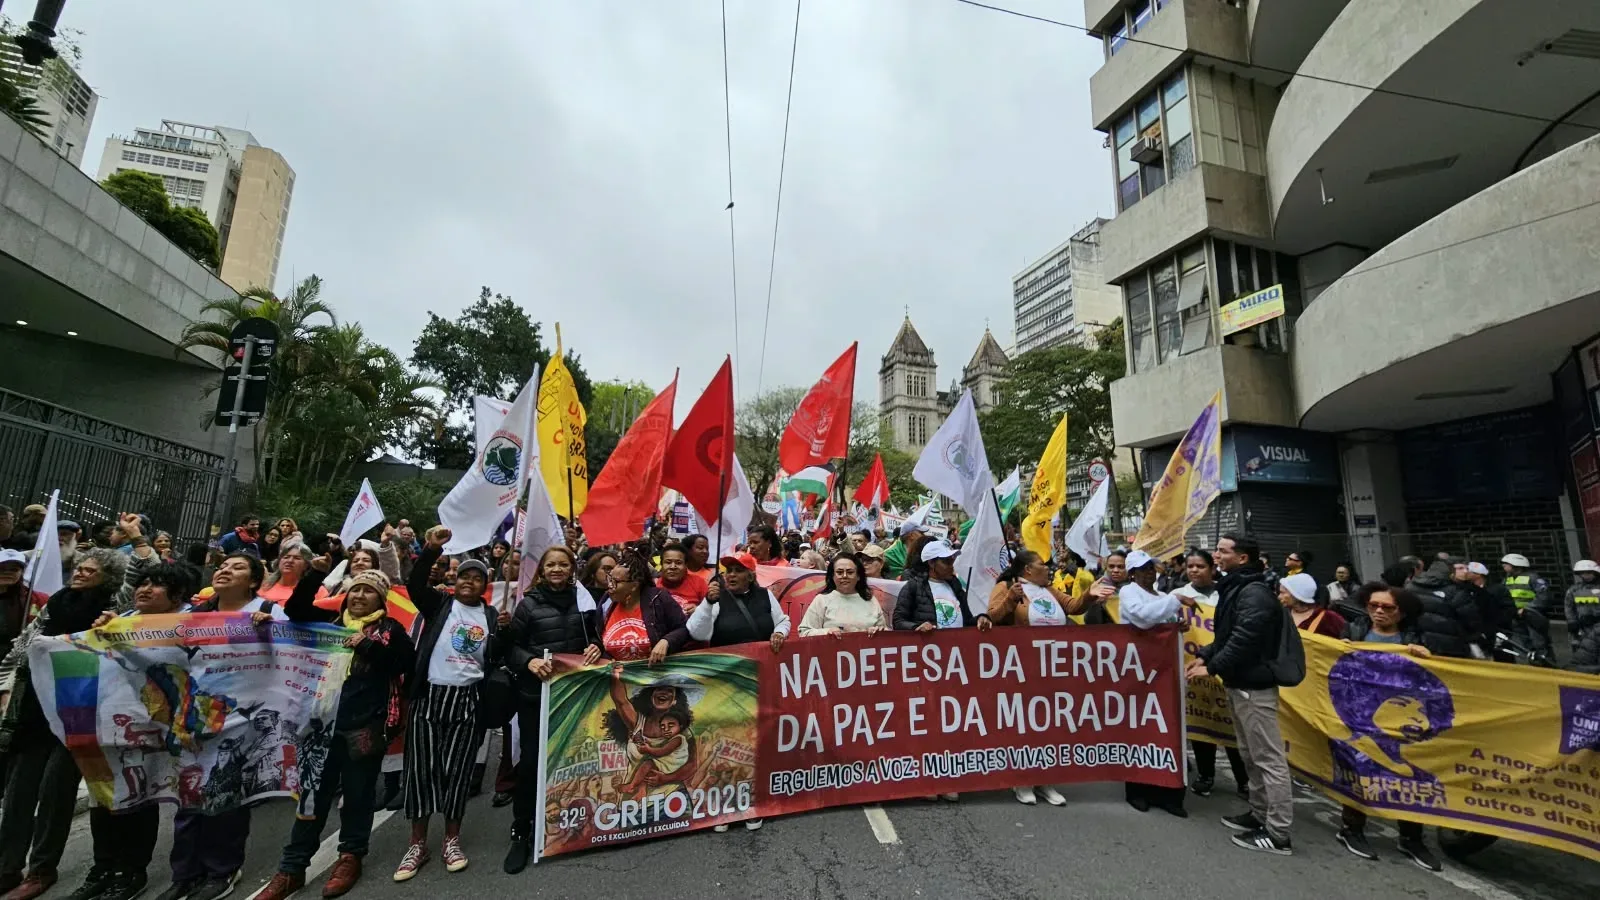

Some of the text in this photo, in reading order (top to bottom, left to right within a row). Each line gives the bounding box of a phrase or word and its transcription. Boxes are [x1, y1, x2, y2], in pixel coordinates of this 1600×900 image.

[1240, 288, 1279, 309] MIRO
[1260, 444, 1310, 462] VISUAL
[780, 639, 1158, 698] NA DEFESA DA TERRA,
[777, 690, 1168, 753] DA PAZ E DA MORADIA
[1470, 748, 1485, 760] A
[770, 743, 1178, 796] ERGUEMOS A VOZ: MULHERES VIVAS E SOBERANIA
[1455, 762, 1511, 784] porta
[594, 791, 687, 831] GRITO
[692, 782, 750, 820] 2026
[1464, 796, 1536, 816] outros
[1528, 787, 1593, 814] todos
[591, 834, 607, 844] DOS
[608, 829, 647, 841] EXCLUÍDOS
[654, 820, 690, 833] EXCLUÍDAS
